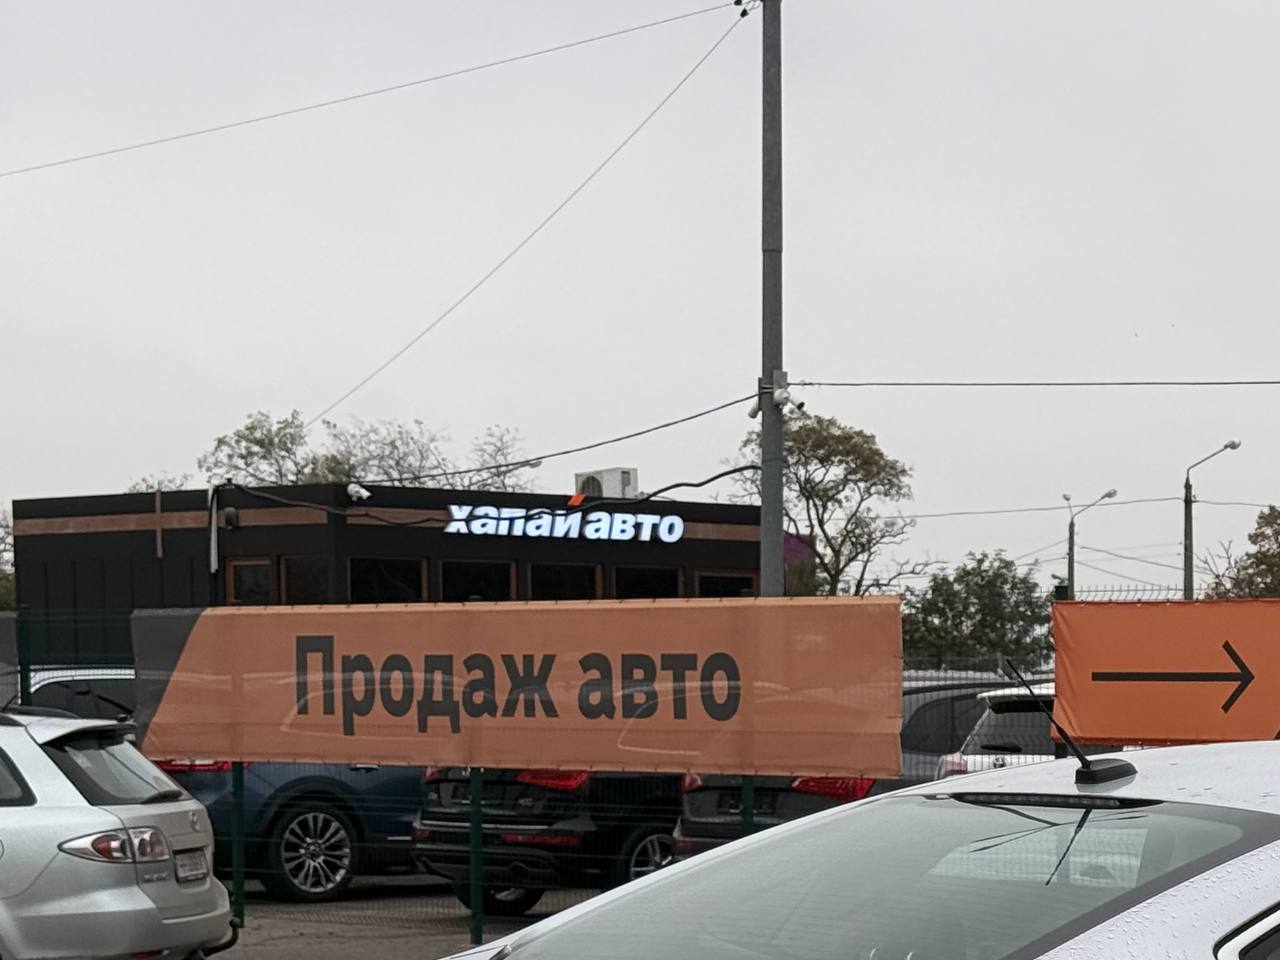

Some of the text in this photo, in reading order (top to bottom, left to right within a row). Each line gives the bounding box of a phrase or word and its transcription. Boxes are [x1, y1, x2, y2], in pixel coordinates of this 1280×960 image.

[584, 511, 684, 544] авто
[295, 635, 741, 736] Продаж авто
